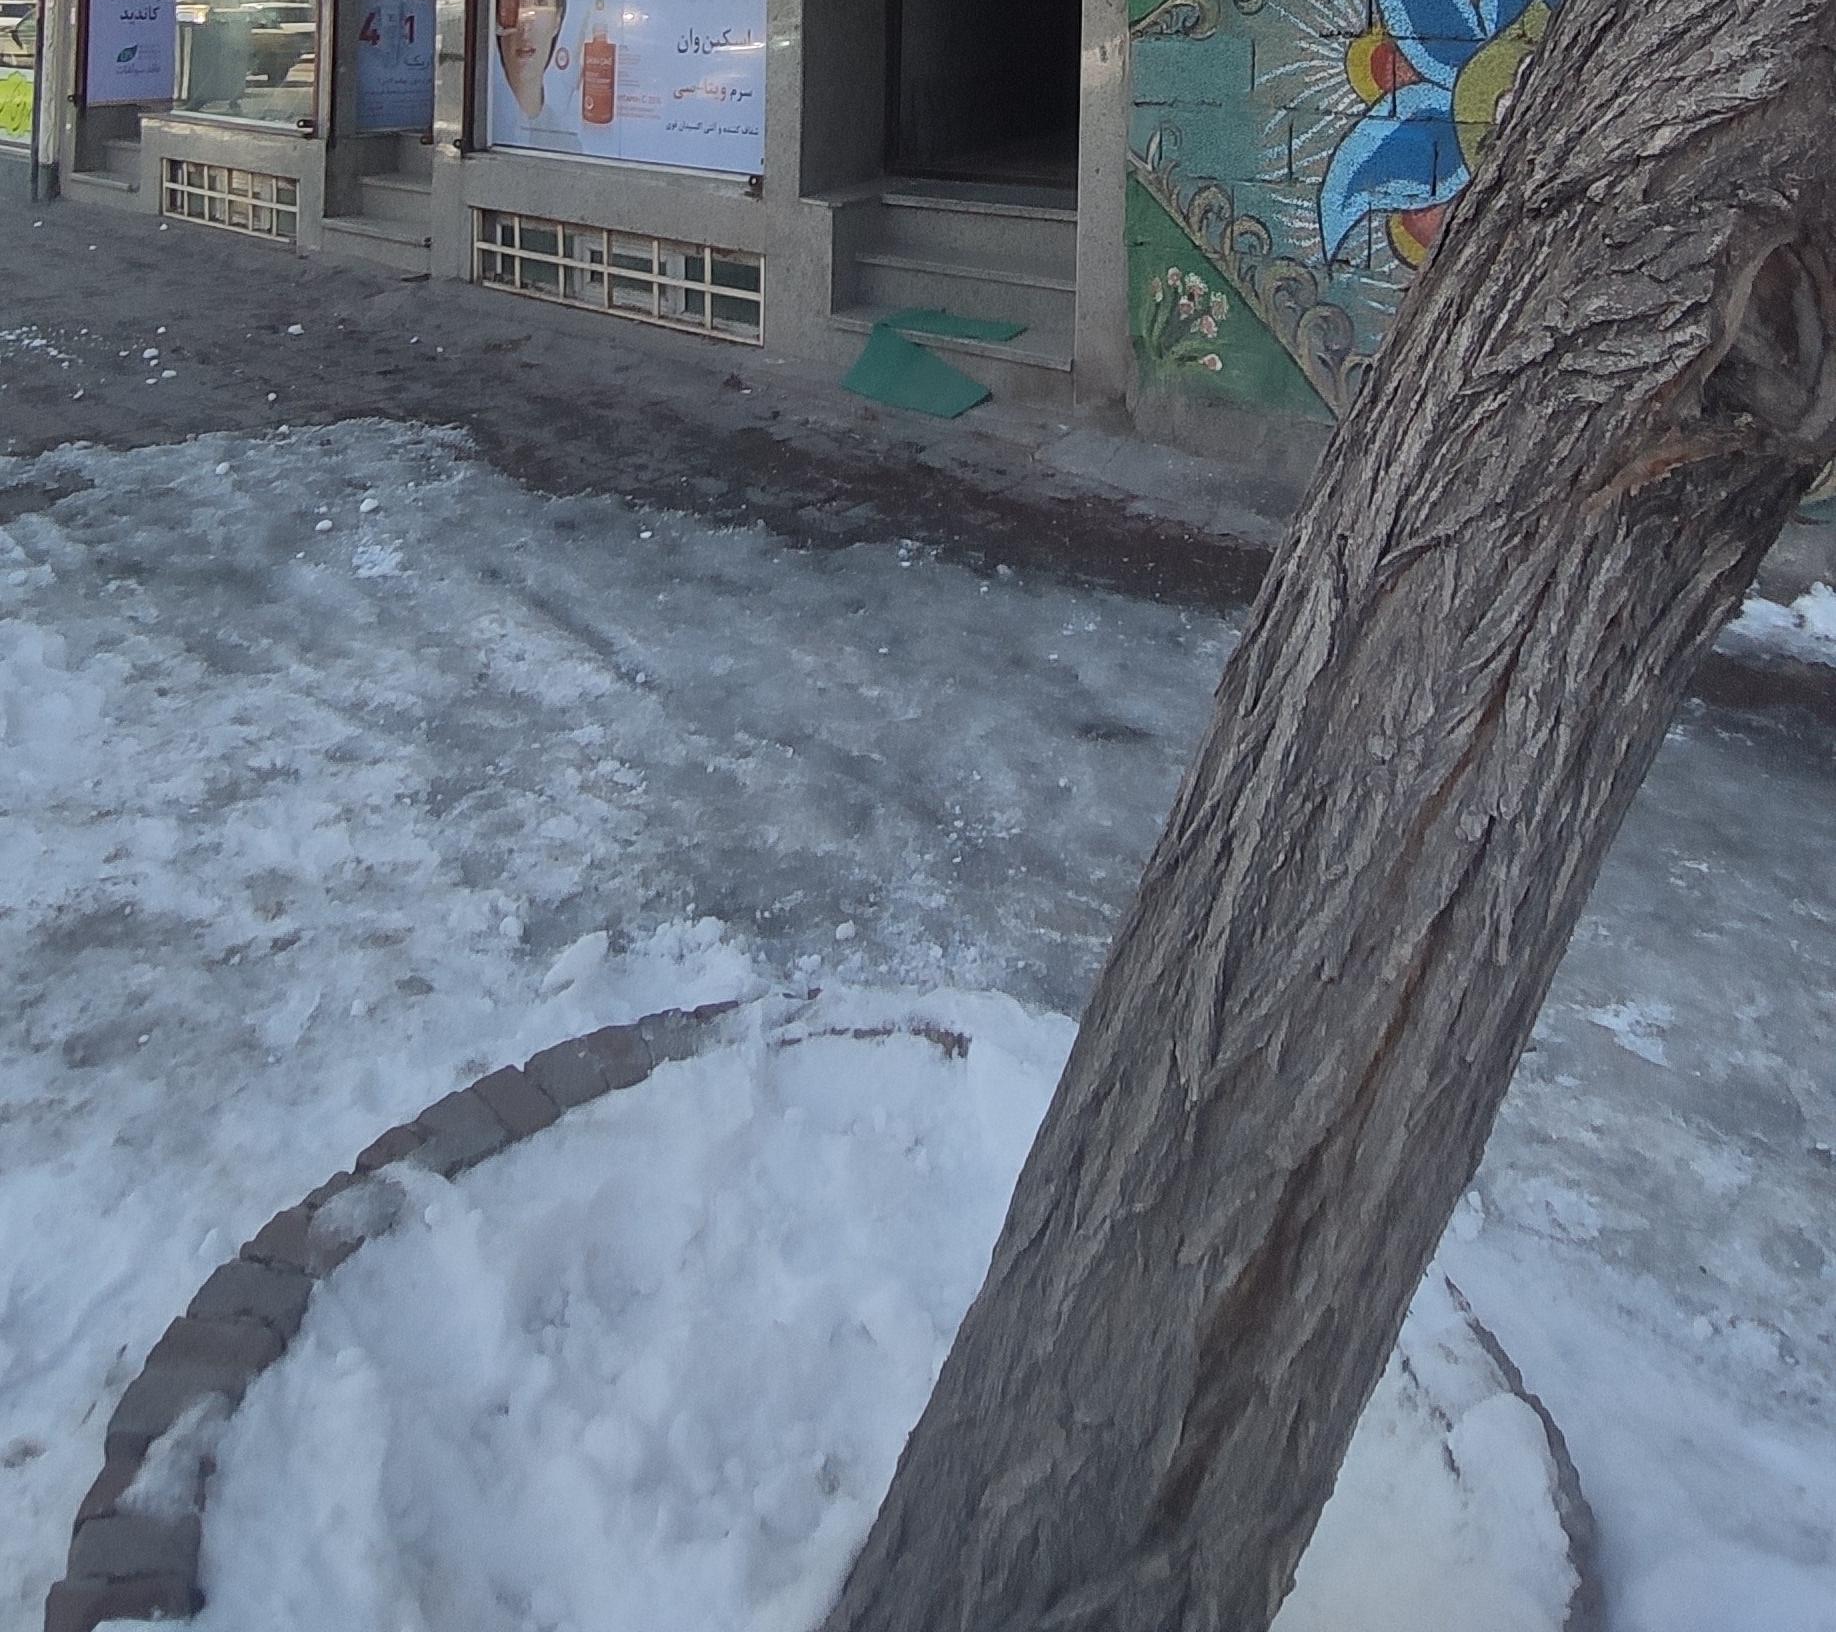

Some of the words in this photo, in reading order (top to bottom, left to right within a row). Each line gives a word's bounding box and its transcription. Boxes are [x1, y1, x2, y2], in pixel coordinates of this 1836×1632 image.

[120, 6, 160, 24] کاندید
[677, 27, 701, 54] وان
[702, 28, 752, 55] اسکین
[730, 85, 753, 102] سرم
